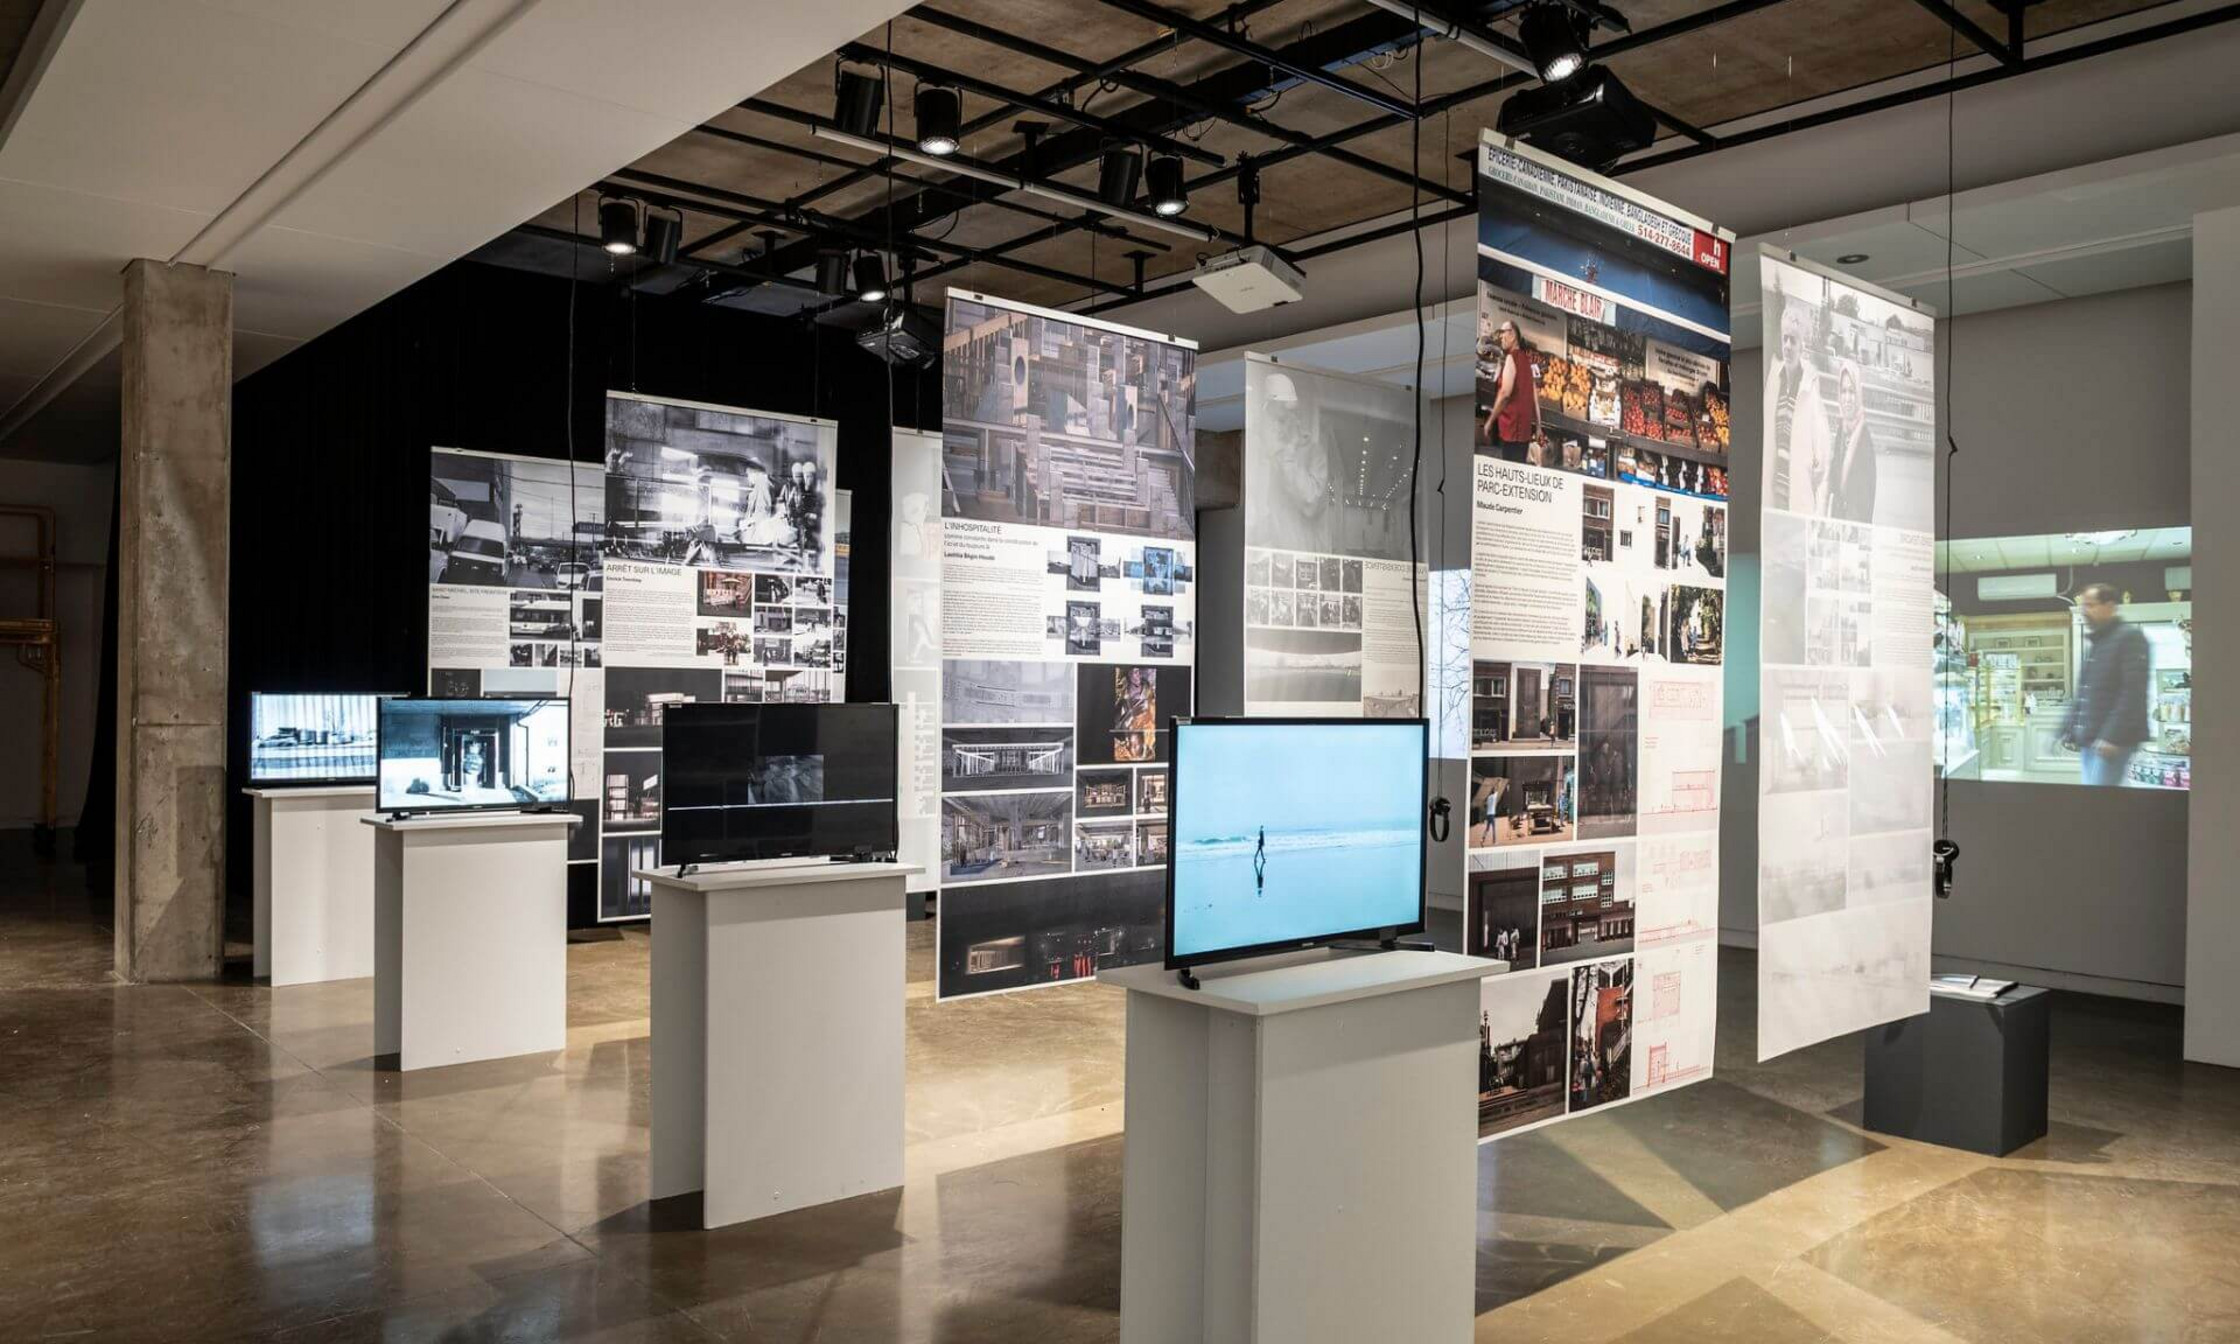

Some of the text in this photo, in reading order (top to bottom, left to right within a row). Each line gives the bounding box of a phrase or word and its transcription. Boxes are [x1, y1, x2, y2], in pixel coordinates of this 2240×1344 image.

[1701, 252, 1720, 270] OPEN
[1581, 292, 1603, 319] BLAIR
[1478, 463, 1564, 490] LES HAUTS-LIEUX DE
[1477, 479, 1553, 504] PARC-EXTENSION
[1477, 500, 1495, 511] Maude
[944, 521, 1003, 535] L'INHOSPITALITÉ
[606, 563, 682, 577] ARRÊT SUR L'IMAGE
